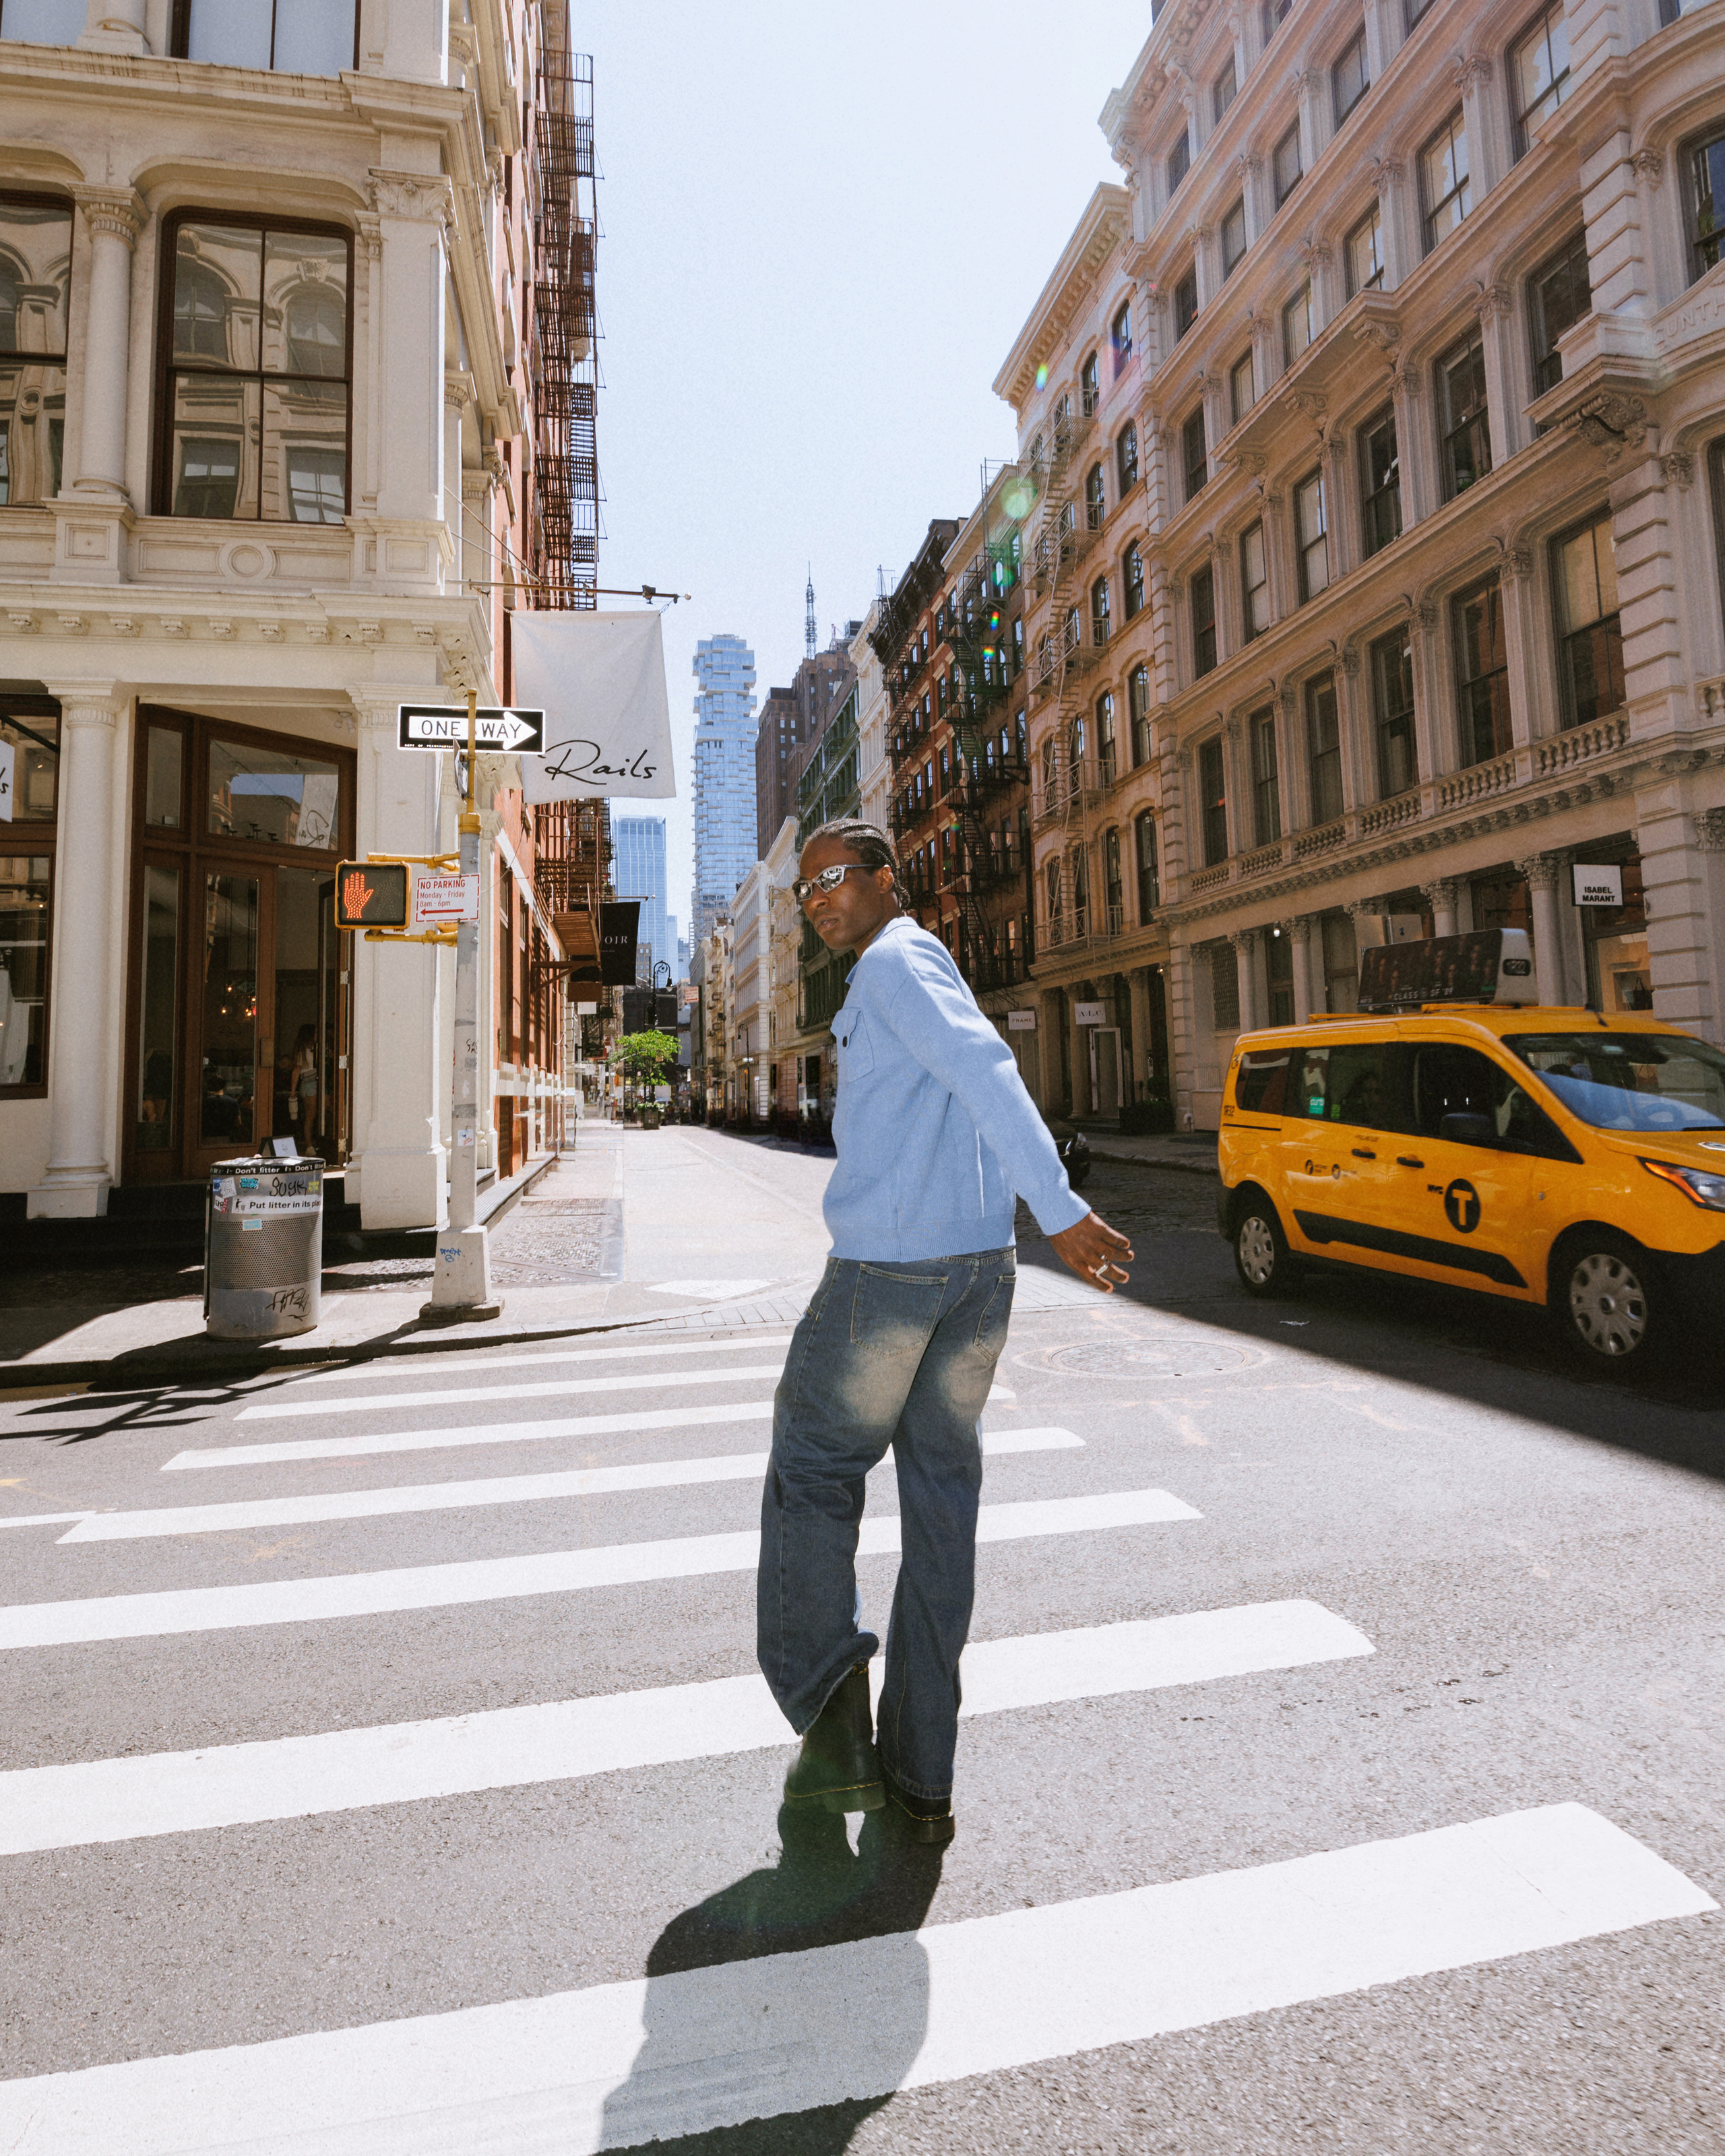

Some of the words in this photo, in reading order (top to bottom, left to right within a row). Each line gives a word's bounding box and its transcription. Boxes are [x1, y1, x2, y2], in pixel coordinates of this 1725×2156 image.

[421, 720, 461, 736] ONE
[481, 722, 522, 738] WAY
[538, 740, 657, 785] Rails
[420, 881, 431, 889] NO
[433, 879, 466, 889] PARKING
[602, 935, 628, 945] OIR
[1393, 990, 1418, 1001] CLASS
[269, 1200, 290, 1209] litter
[1451, 1188, 1473, 1226] T
